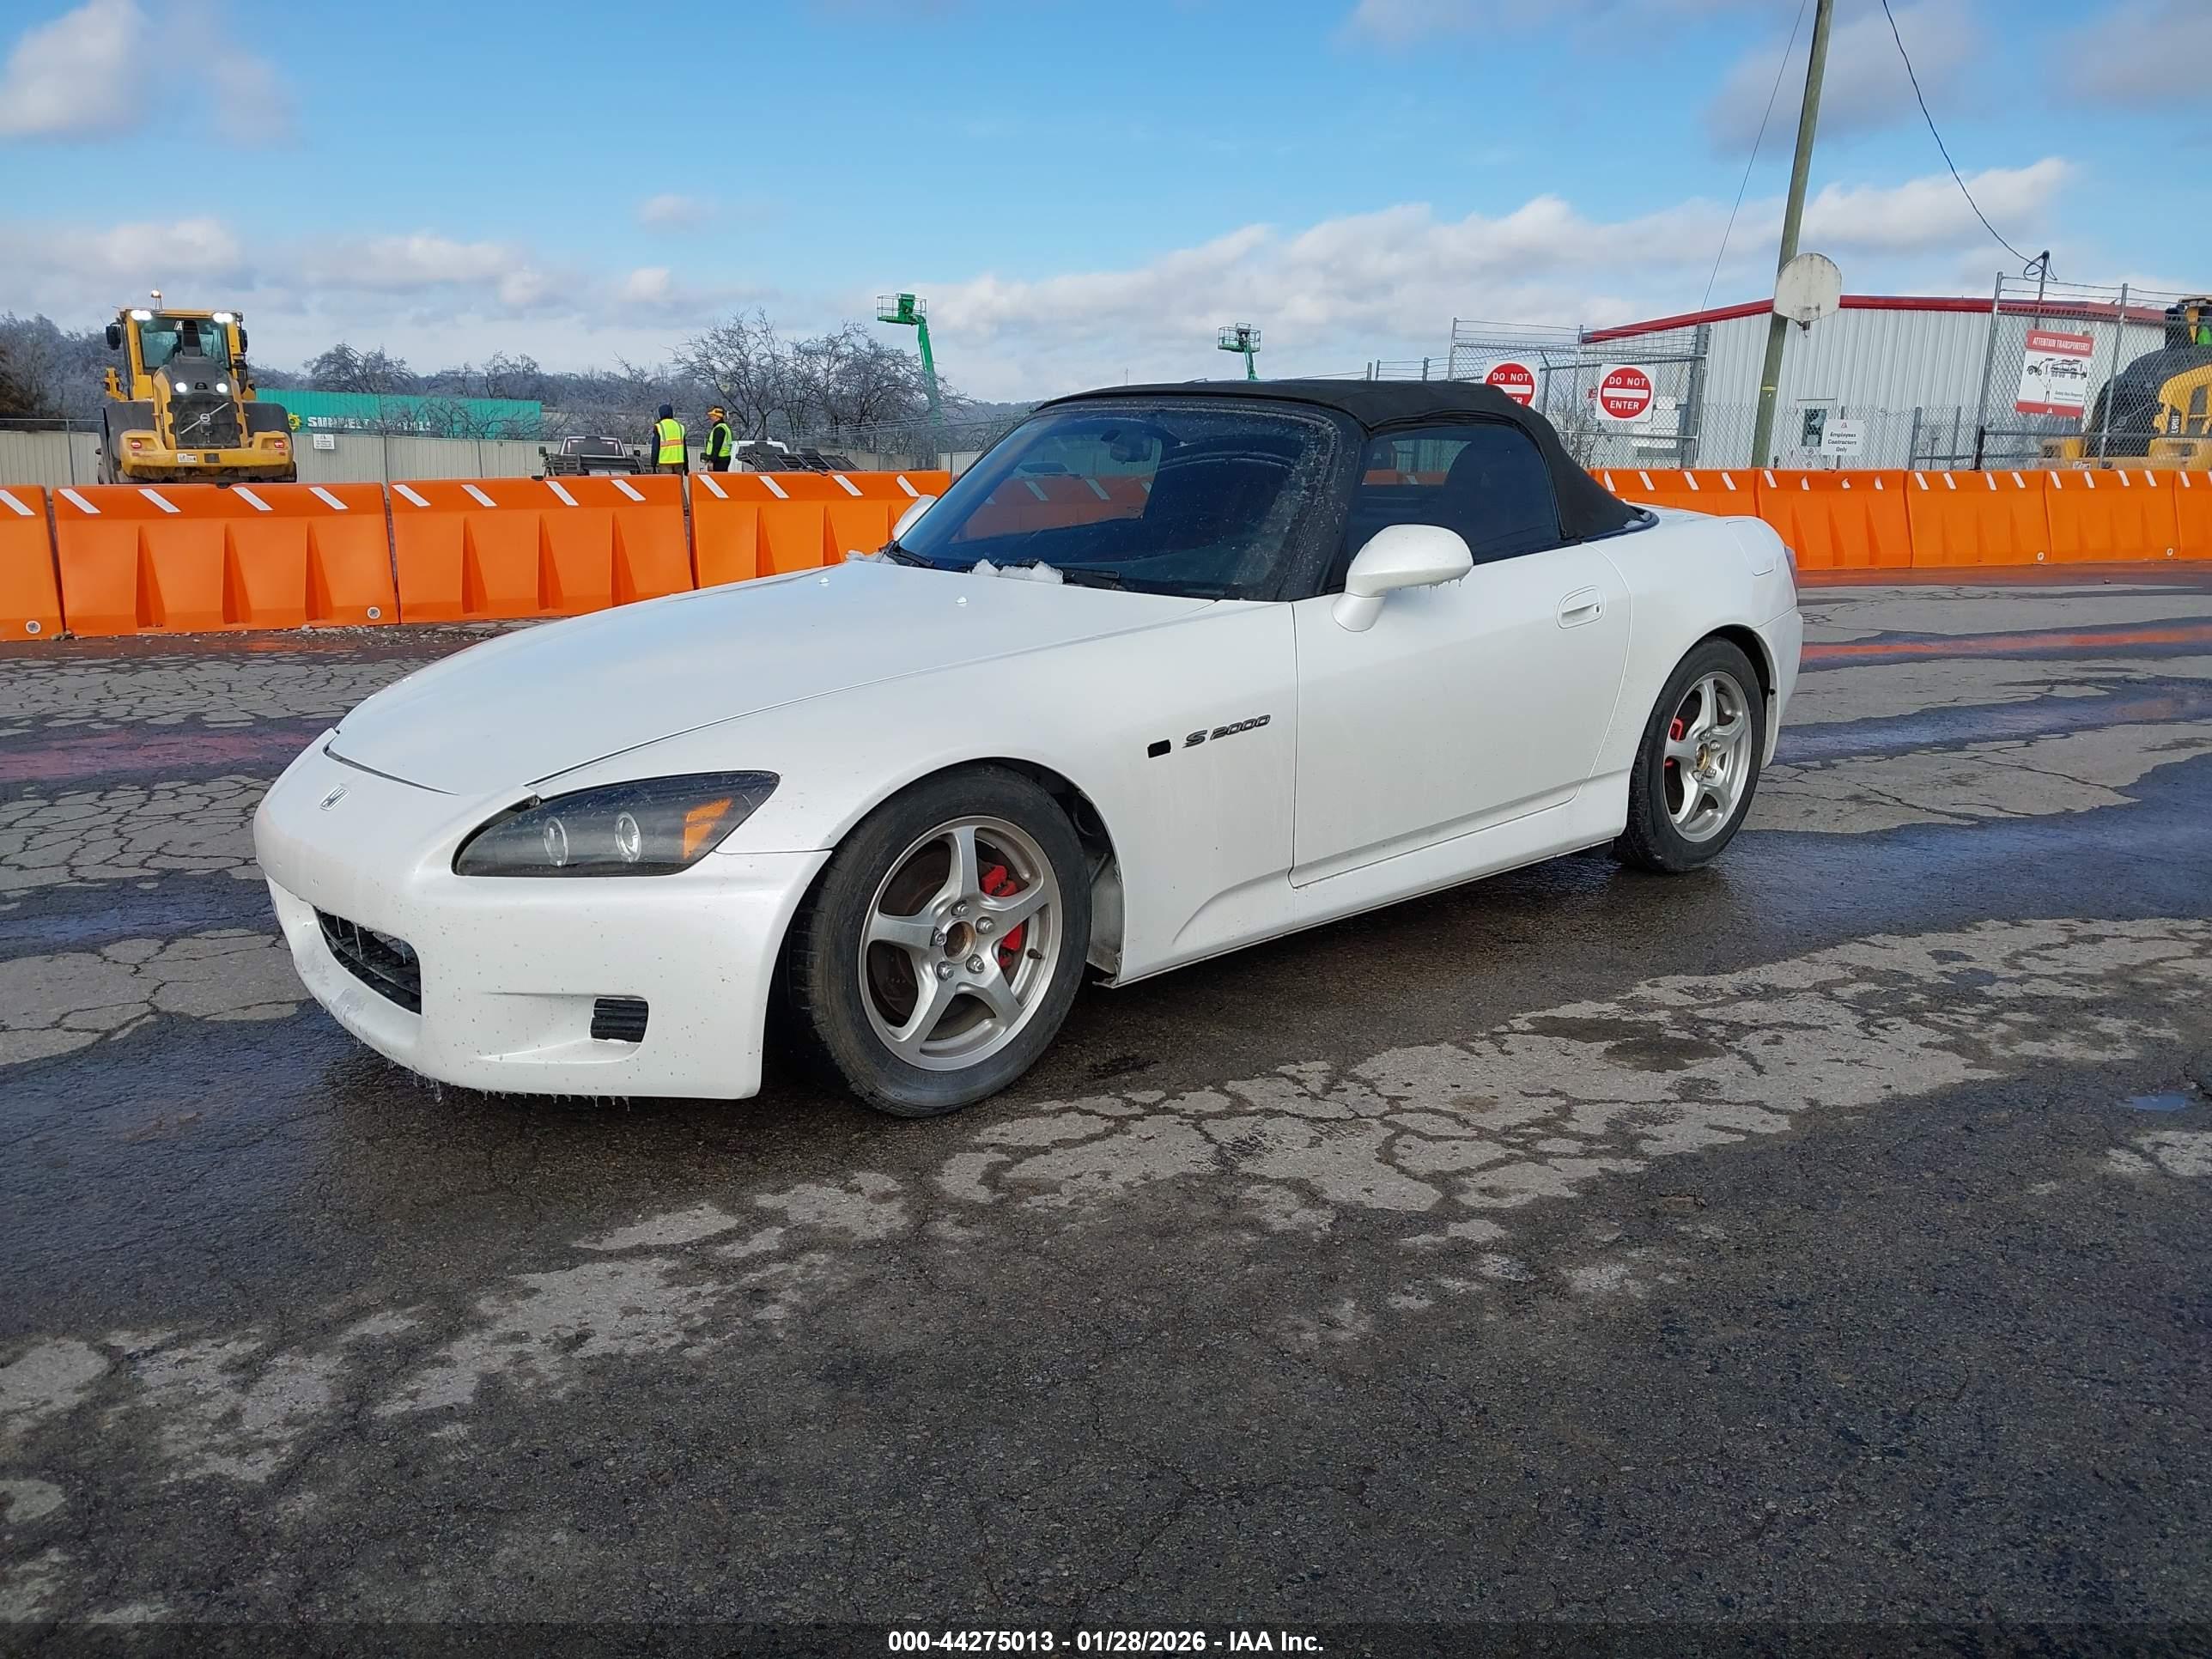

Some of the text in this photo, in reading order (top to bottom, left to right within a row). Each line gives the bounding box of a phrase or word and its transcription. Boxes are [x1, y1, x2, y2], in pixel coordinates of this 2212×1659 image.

[2033, 337, 2056, 347] ATTENTION
[1492, 372, 1528, 382] DO NOT
[1608, 376, 1646, 386] DO NOT
[1609, 399, 1640, 410] ENTER
[1182, 714, 1271, 748] S 2000
